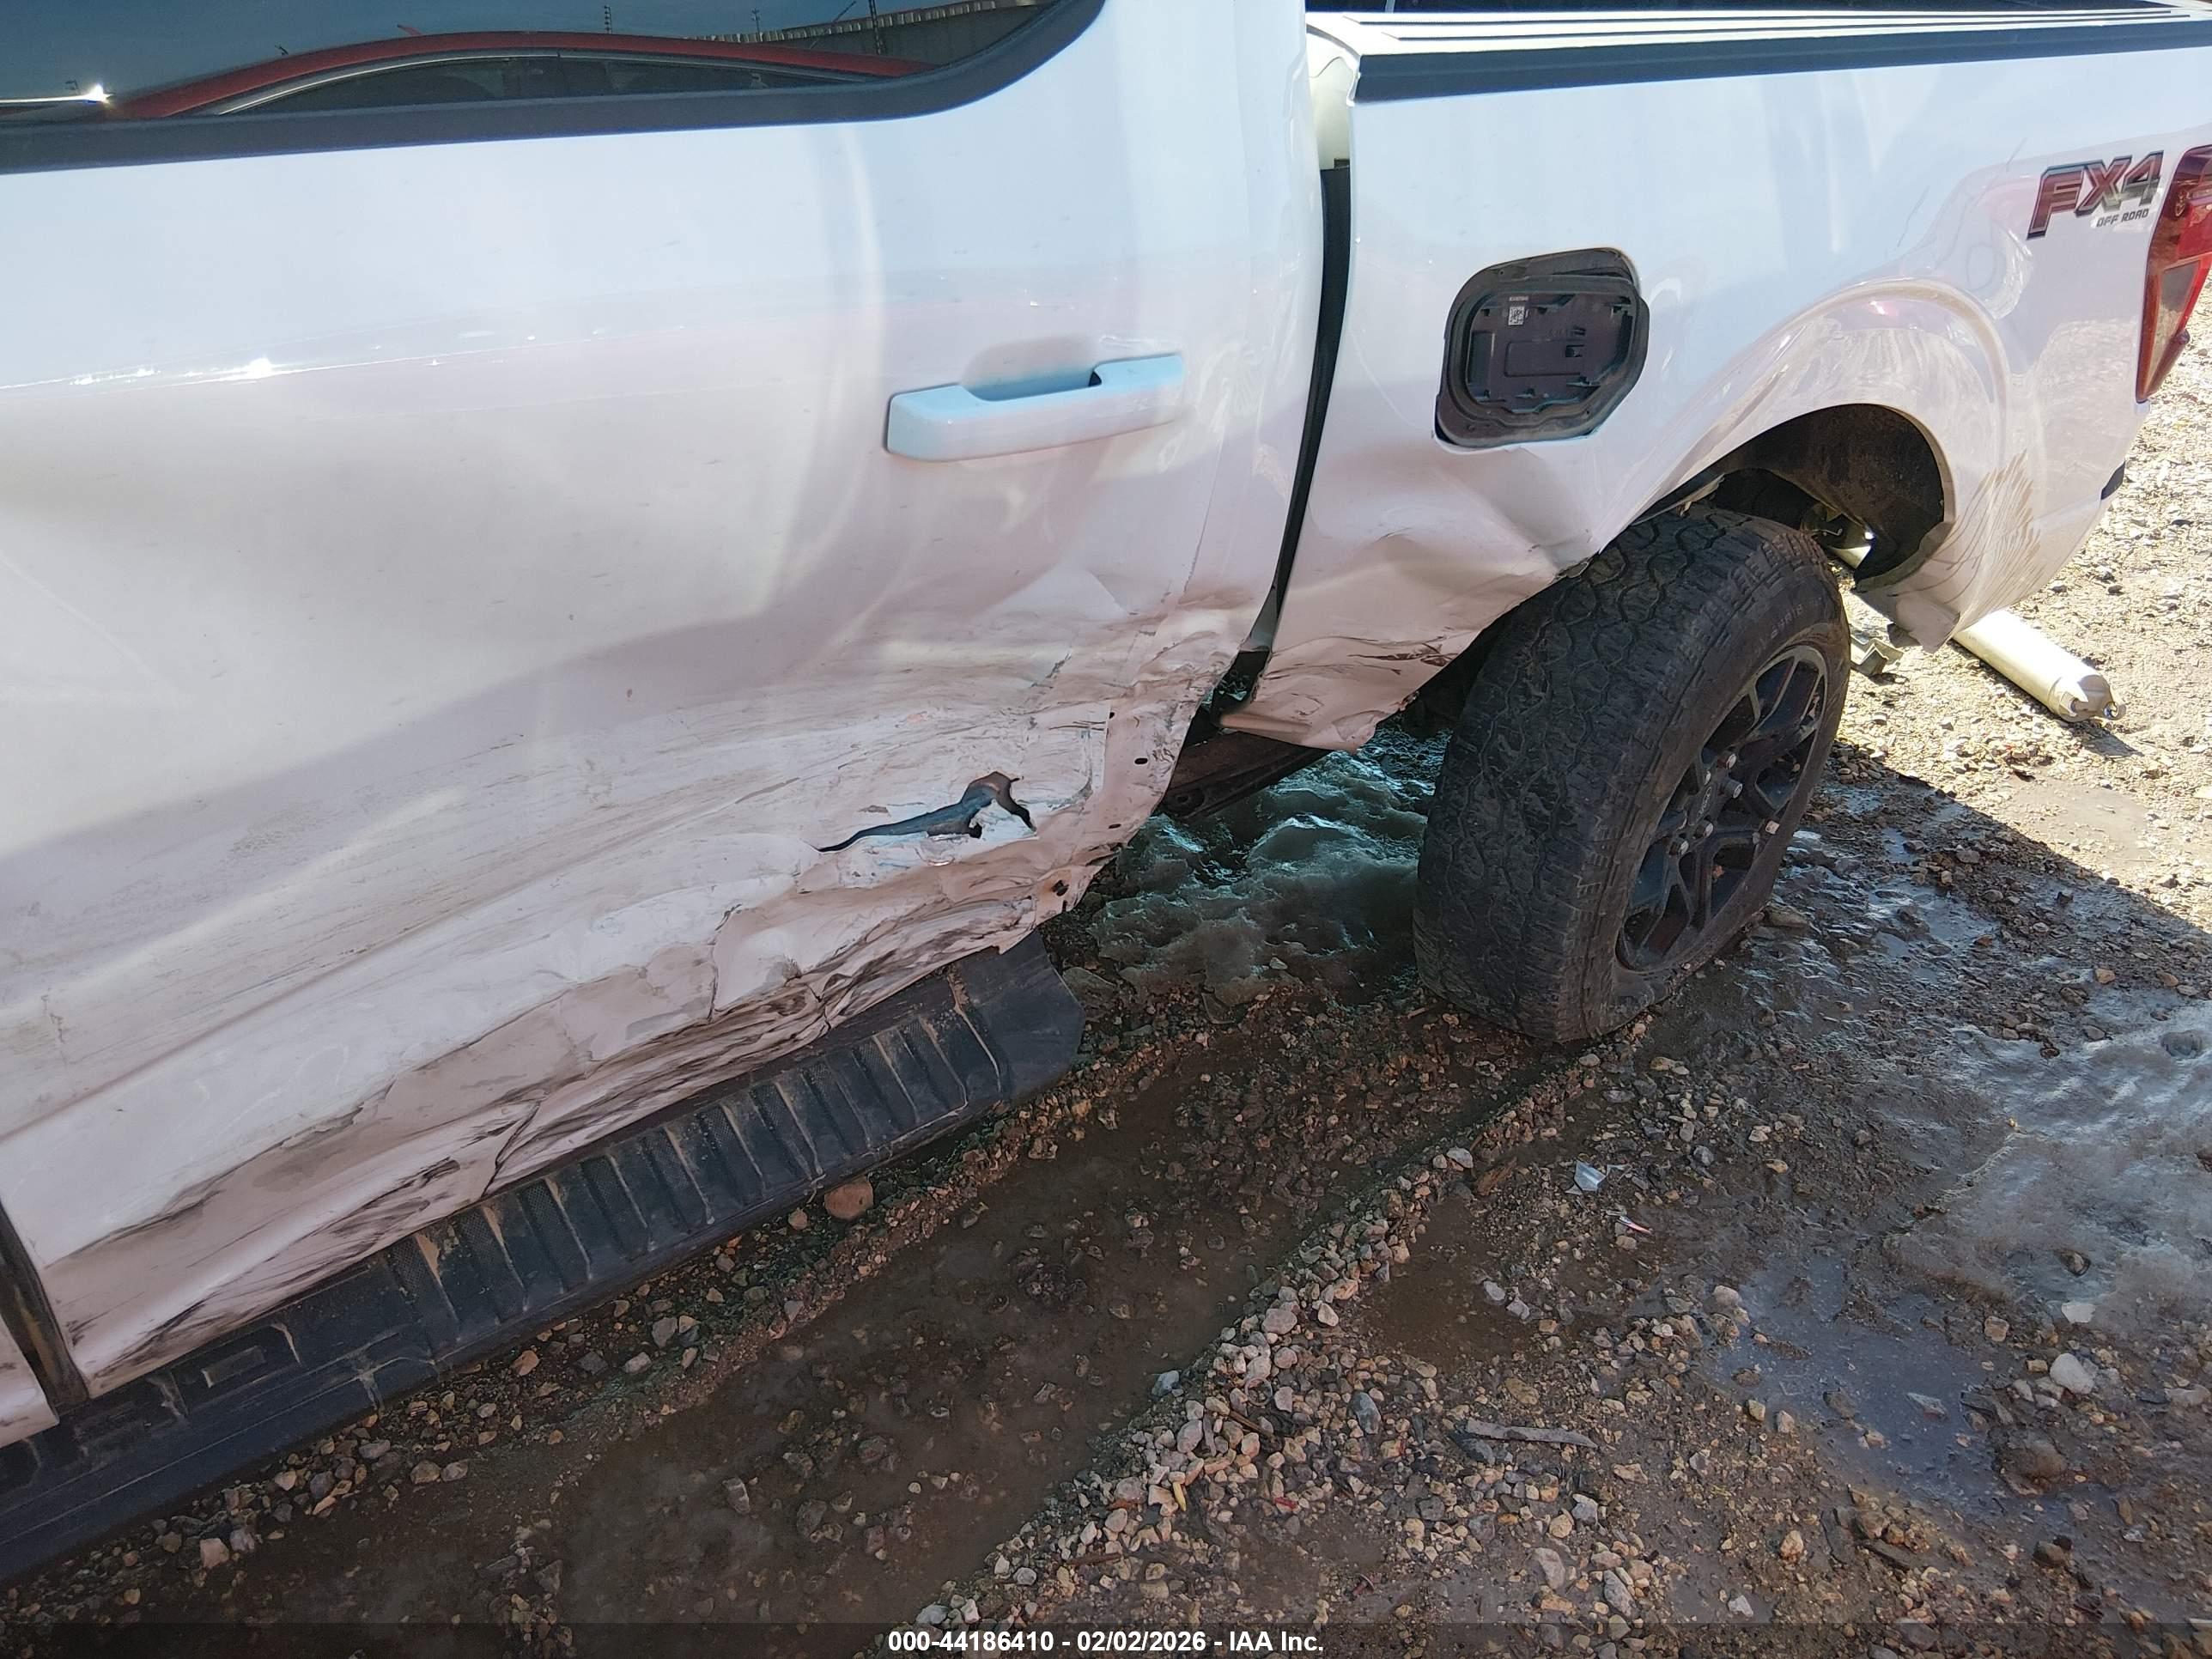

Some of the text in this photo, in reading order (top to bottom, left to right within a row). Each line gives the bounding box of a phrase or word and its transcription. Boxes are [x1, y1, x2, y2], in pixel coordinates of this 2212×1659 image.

[2027, 150, 2164, 240] FX4
[2096, 208, 2148, 227] OFF ROAD
